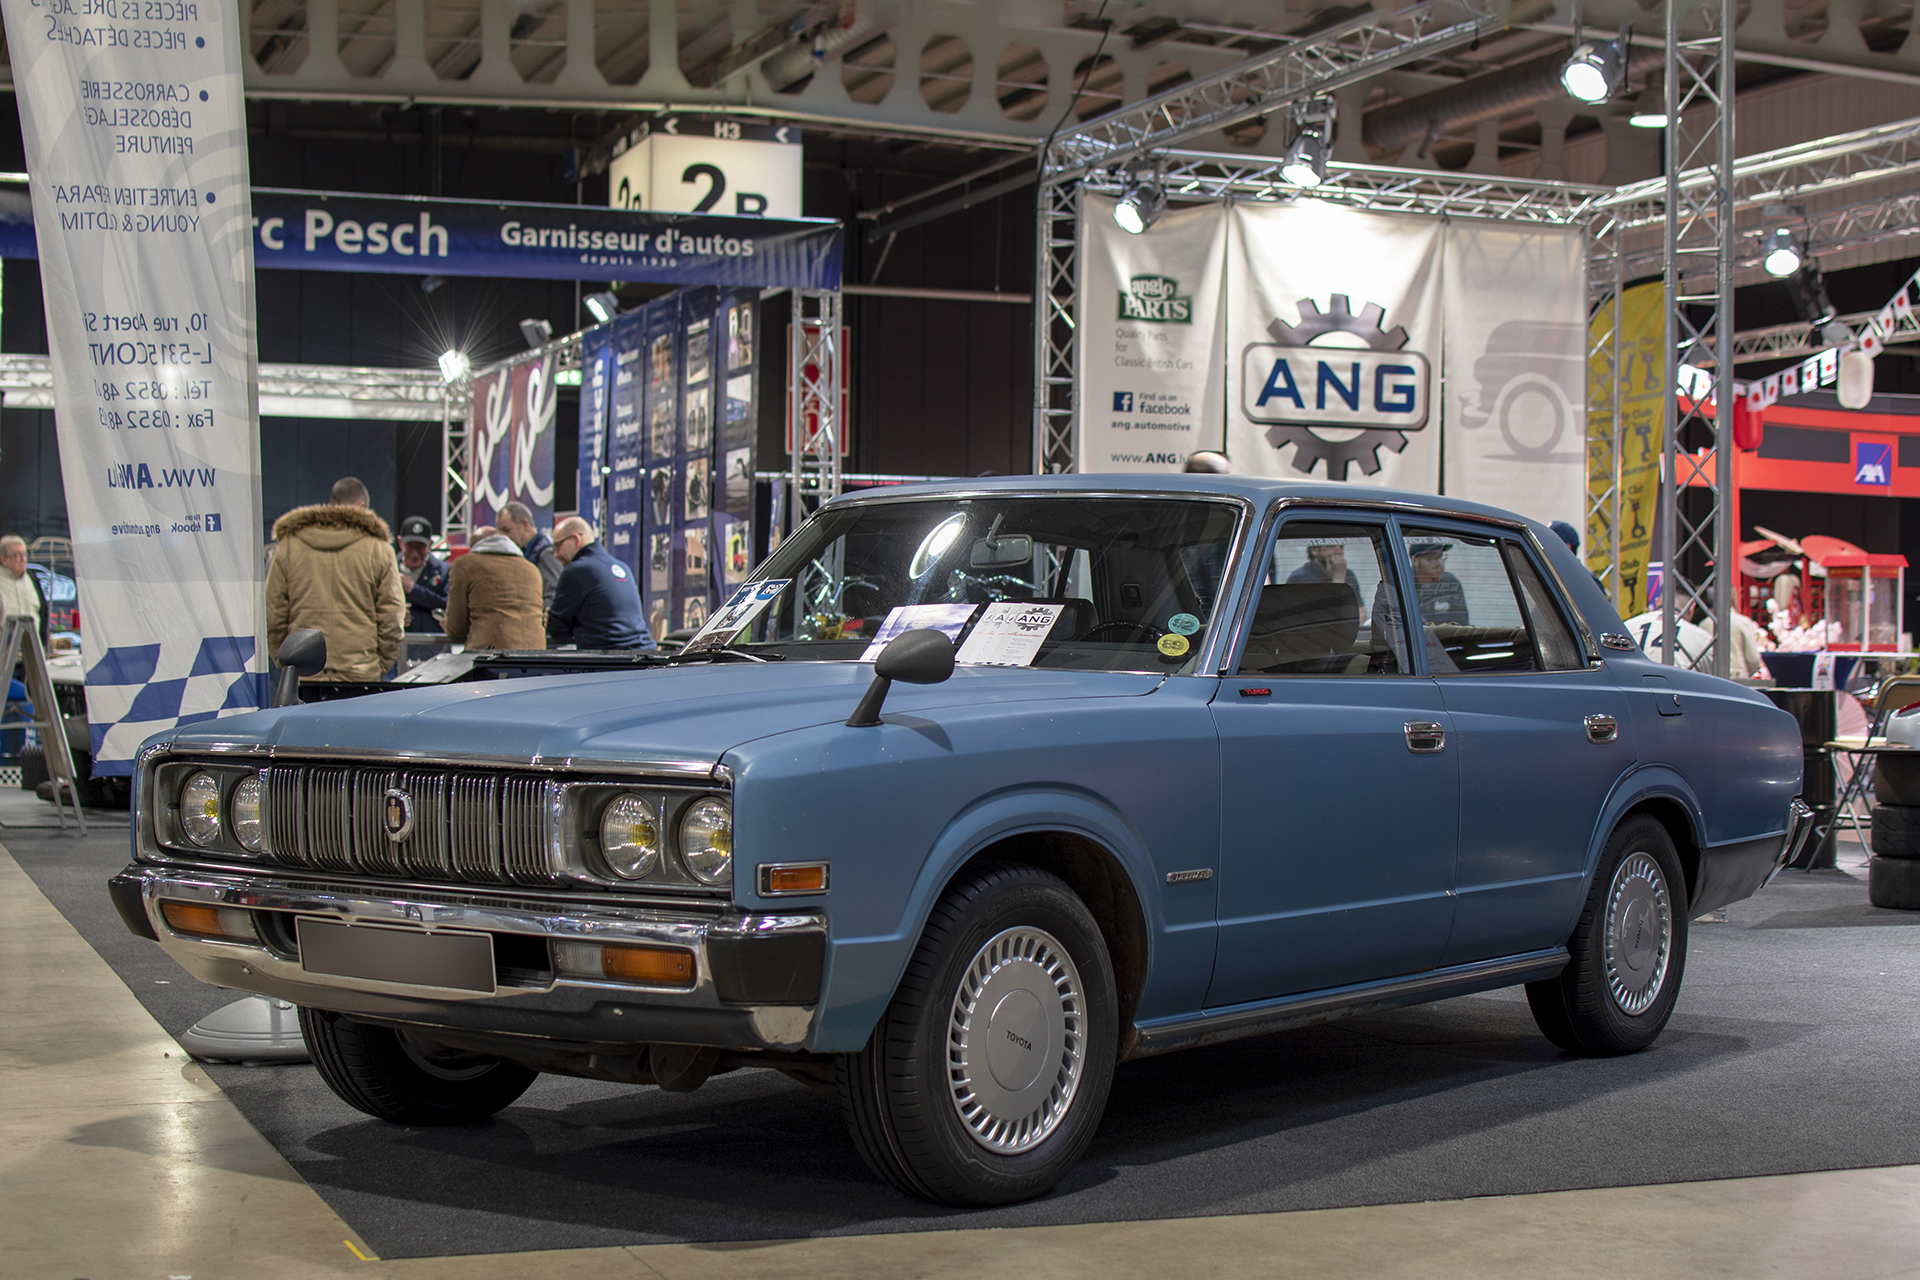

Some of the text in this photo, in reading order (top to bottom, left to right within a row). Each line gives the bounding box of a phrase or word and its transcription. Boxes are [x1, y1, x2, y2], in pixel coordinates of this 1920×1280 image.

[714, 121, 741, 140] H3
[305, 209, 448, 257] Pesch
[501, 221, 754, 257] Garnisseur d'autos
[580, 253, 678, 267] depuis 1930
[1132, 278, 1175, 299] anglo
[1123, 295, 1189, 320] PARTS
[1115, 356, 1145, 367] Classic
[1255, 358, 1417, 413] ANG
[1139, 401, 1191, 415] facebook
[1111, 420, 1191, 432] ang.automotive
[1855, 464, 1886, 484] AXA
[1018, 614, 1051, 624] ANG
[1006, 1030, 1032, 1051] TOYOTA
